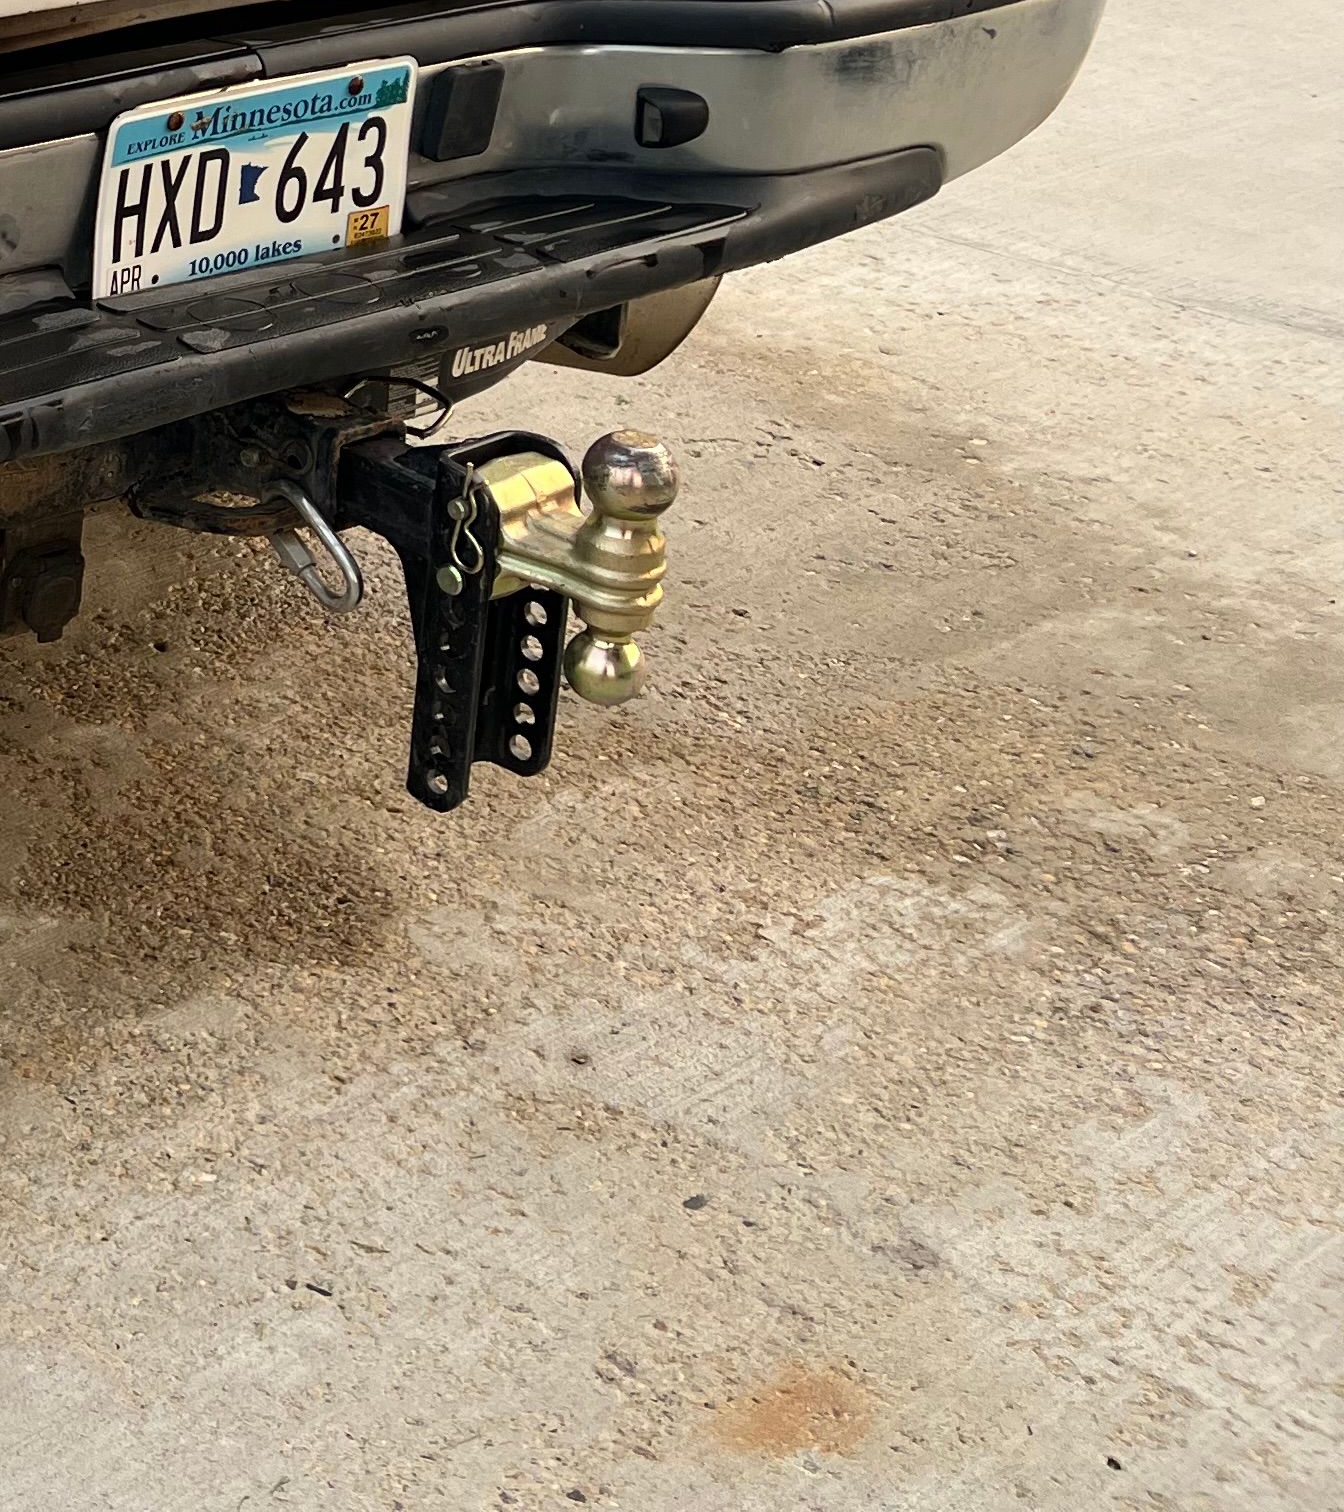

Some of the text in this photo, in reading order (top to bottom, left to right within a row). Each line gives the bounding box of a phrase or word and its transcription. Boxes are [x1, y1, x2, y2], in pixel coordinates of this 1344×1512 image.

[126, 92, 373, 155] EXPLORE Minnesota.com
[112, 116, 388, 265] HXD 643
[359, 212, 379, 231] 27
[188, 239, 302, 277] 10,000 lakes
[109, 265, 142, 296] APR
[452, 341, 506, 378] ULTRA
